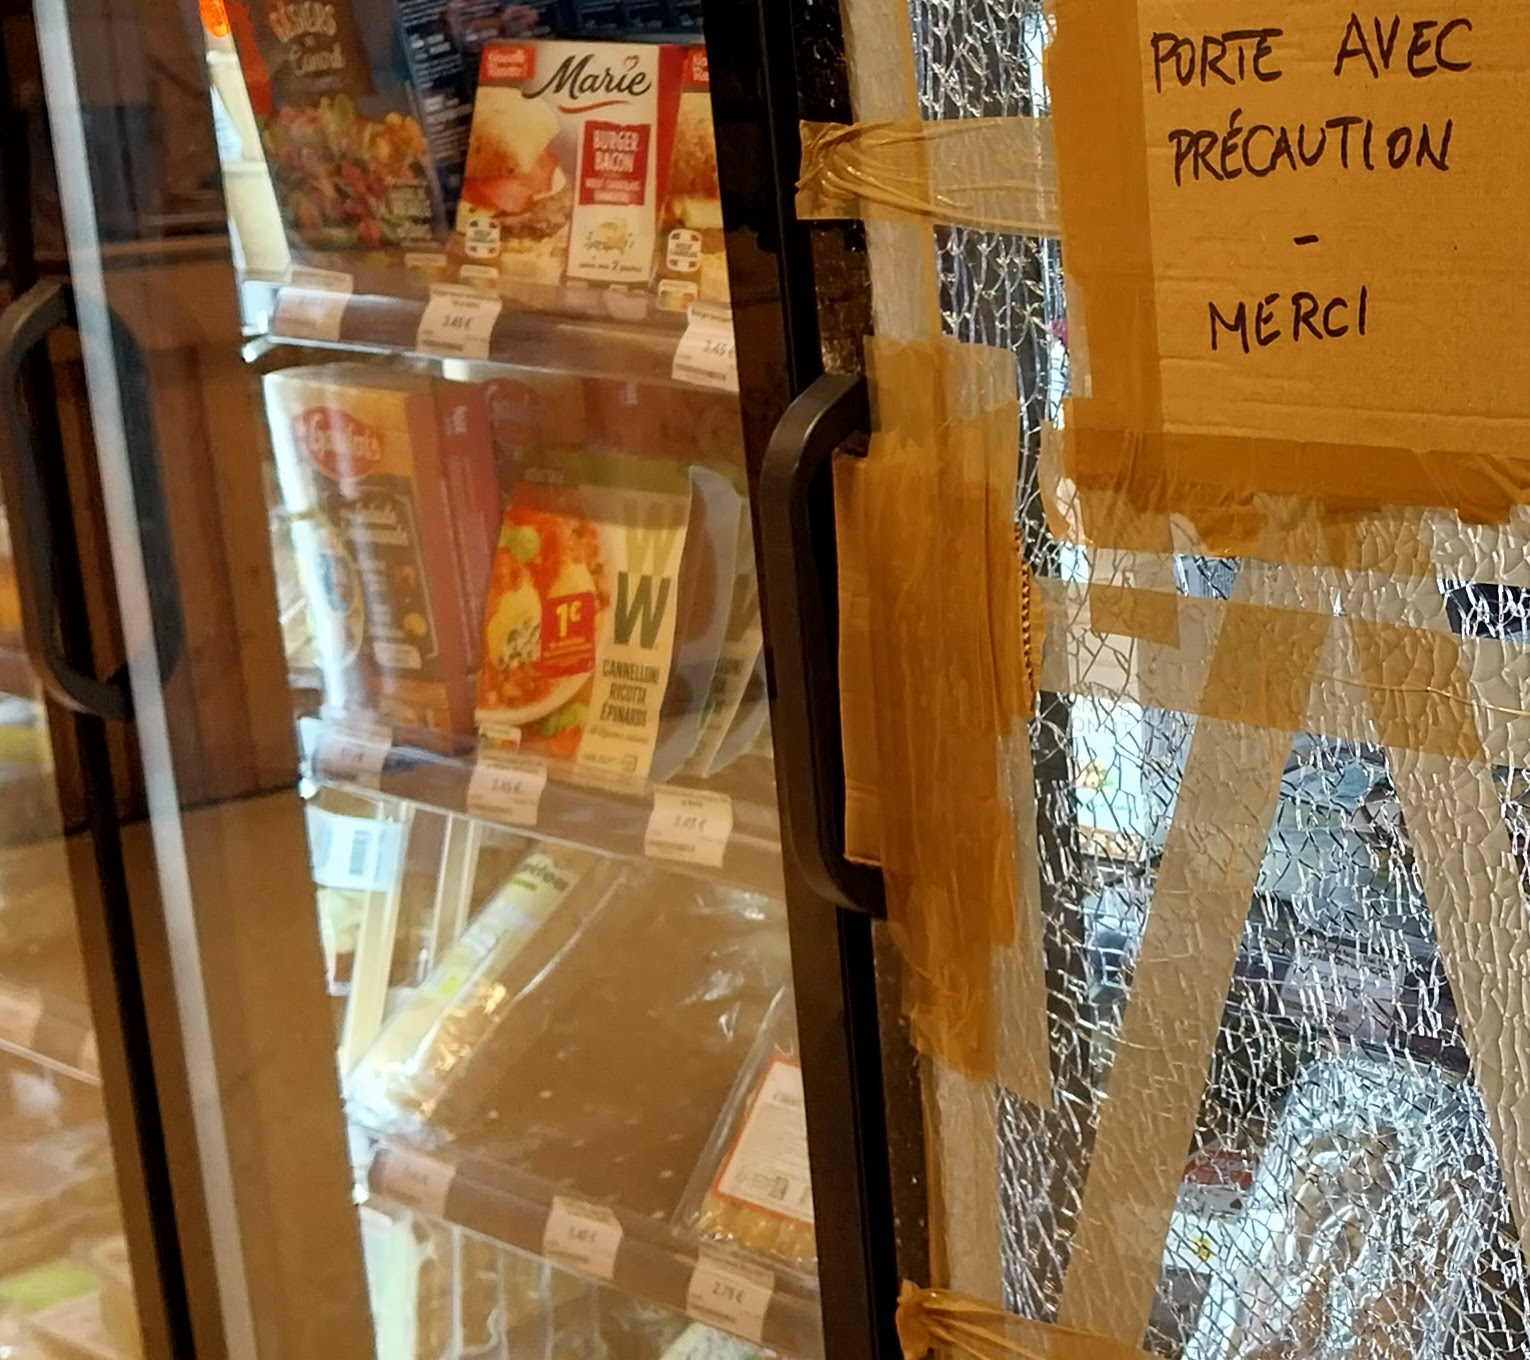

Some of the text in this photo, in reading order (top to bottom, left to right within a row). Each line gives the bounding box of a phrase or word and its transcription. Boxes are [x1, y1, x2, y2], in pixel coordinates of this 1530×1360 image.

[521, 53, 653, 100] Marie
[1150, 11, 1474, 94] PORTE AVEC
[593, 150, 635, 174] BACON
[1166, 107, 1454, 188] PRÉCAUTION
[1207, 285, 1369, 354] MERCI
[613, 570, 672, 651] W
